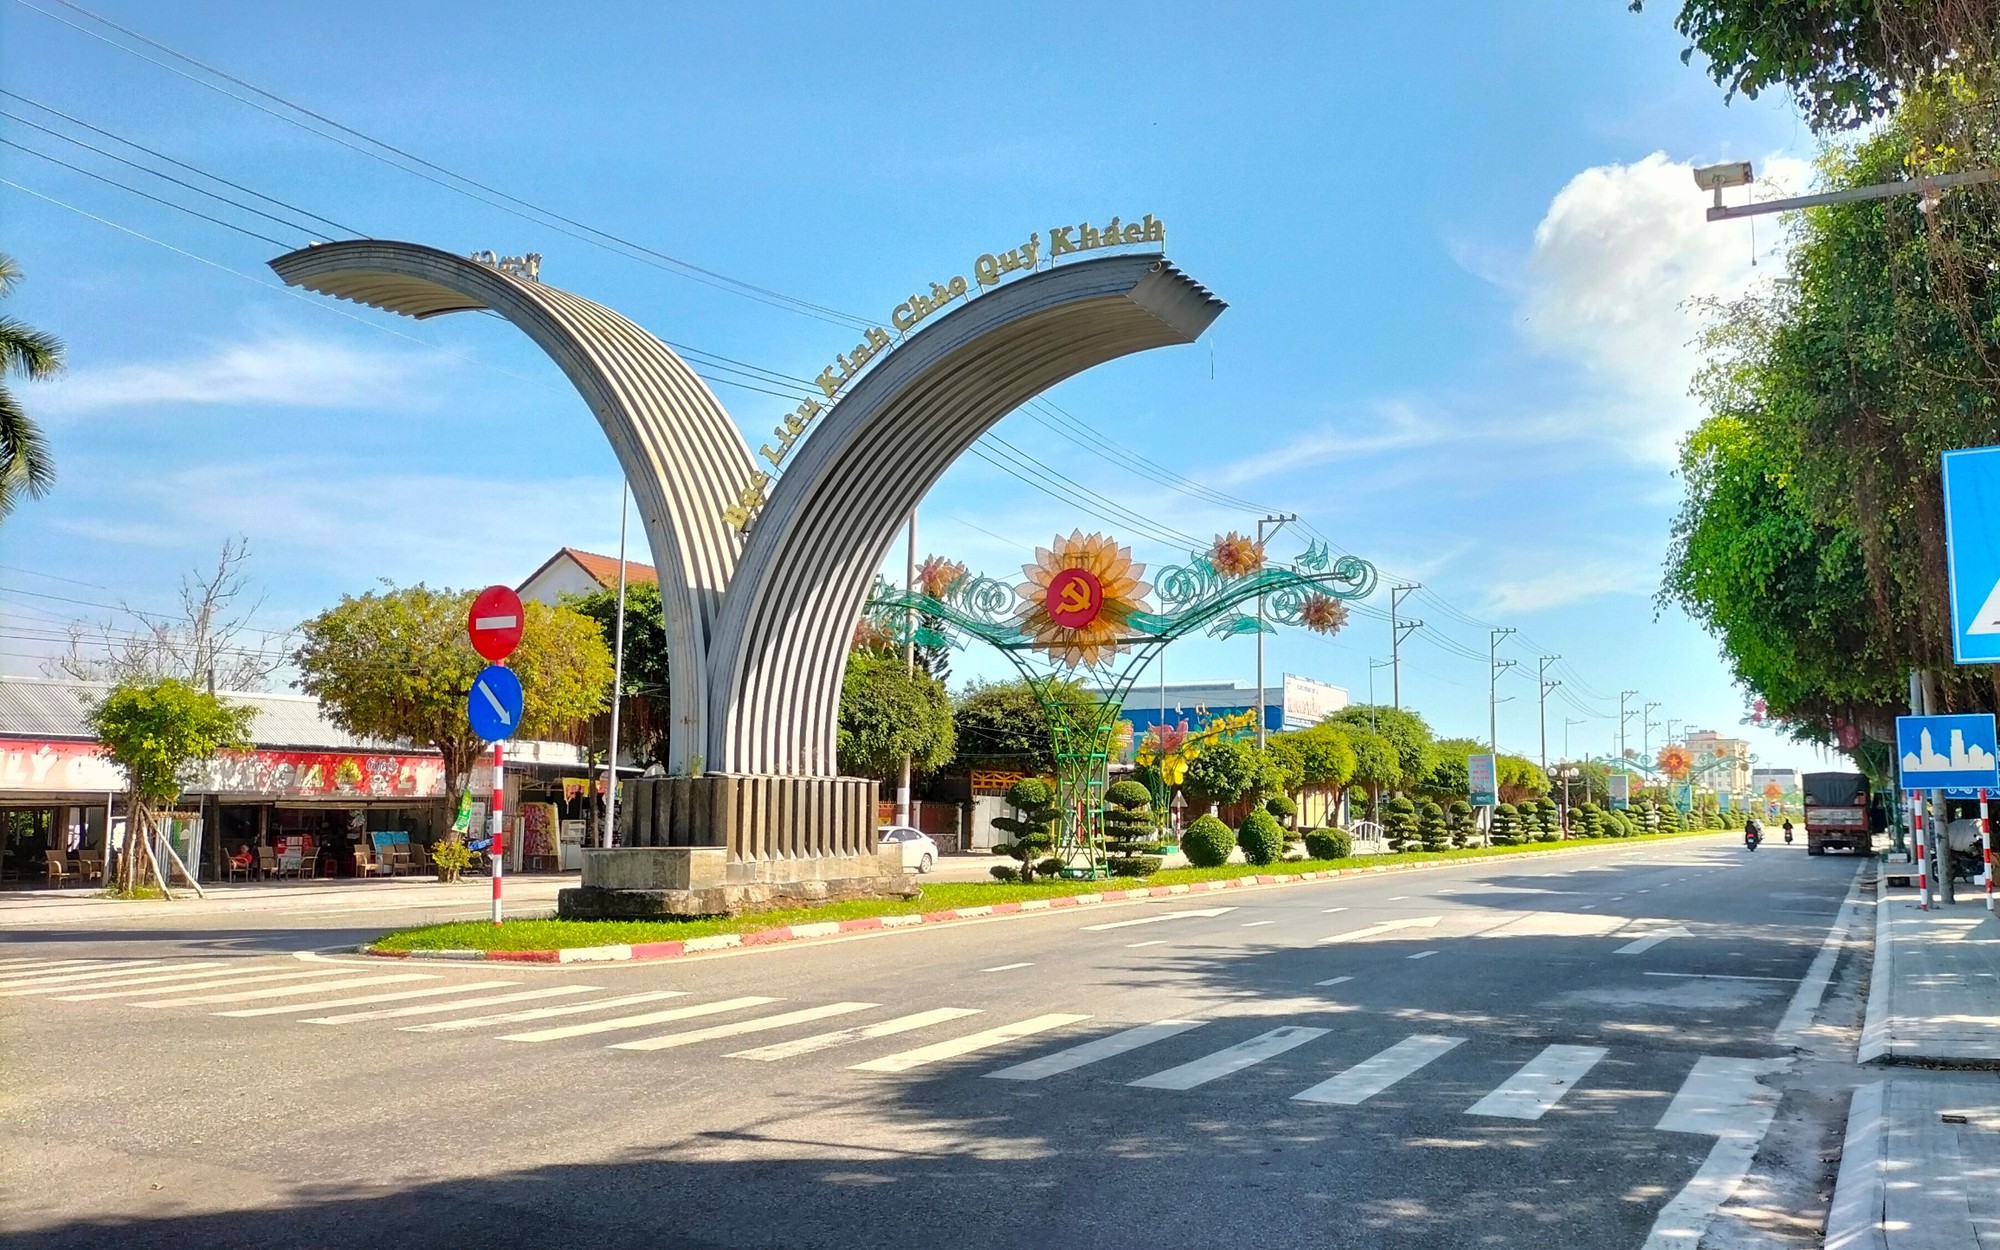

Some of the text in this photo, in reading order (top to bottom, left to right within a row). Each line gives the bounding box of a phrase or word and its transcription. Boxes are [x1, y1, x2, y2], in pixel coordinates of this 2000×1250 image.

[759, 396, 821, 465] Liêu
[892, 275, 968, 332] Chào
[975, 232, 1040, 286] Quý
[1049, 213, 1163, 256] Khách
